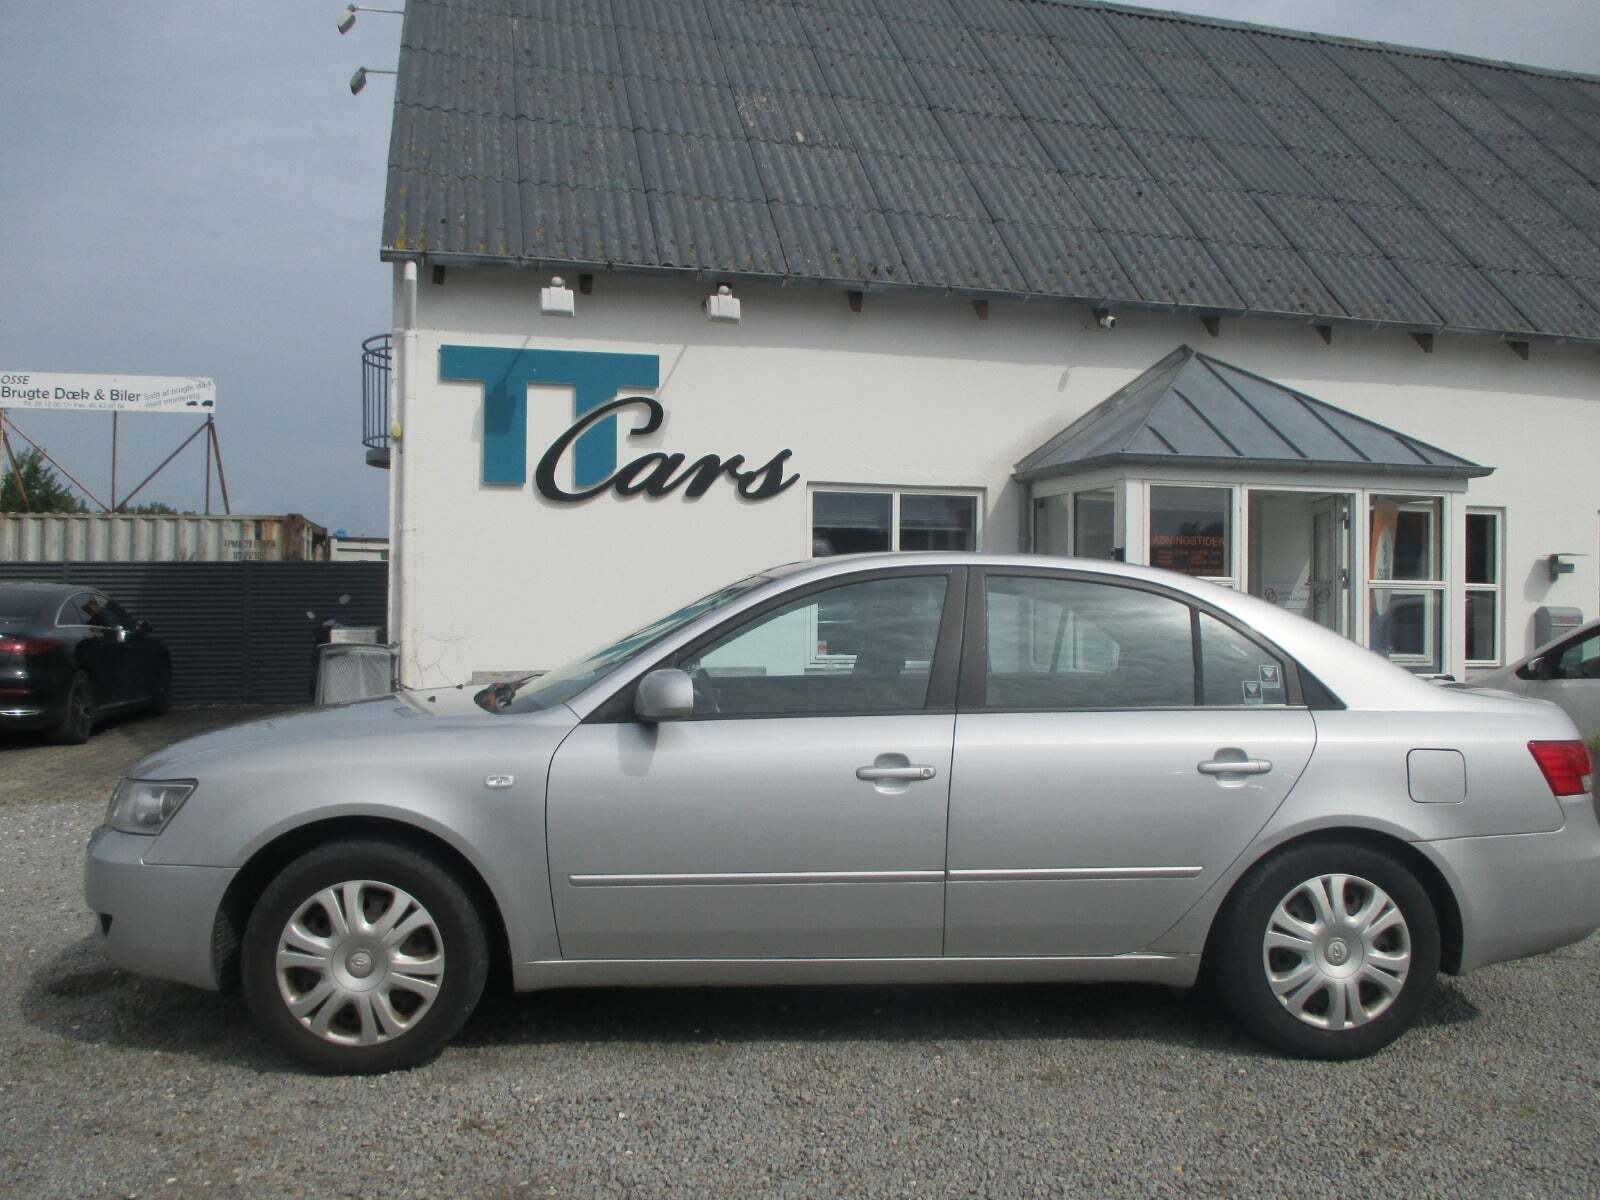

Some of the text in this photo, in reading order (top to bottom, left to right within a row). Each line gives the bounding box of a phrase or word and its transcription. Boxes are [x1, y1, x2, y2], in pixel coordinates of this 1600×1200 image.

[1, 386, 141, 402] Brugte Dæk & Biler
[440, 344, 660, 487] TT
[535, 396, 800, 501] Cars
